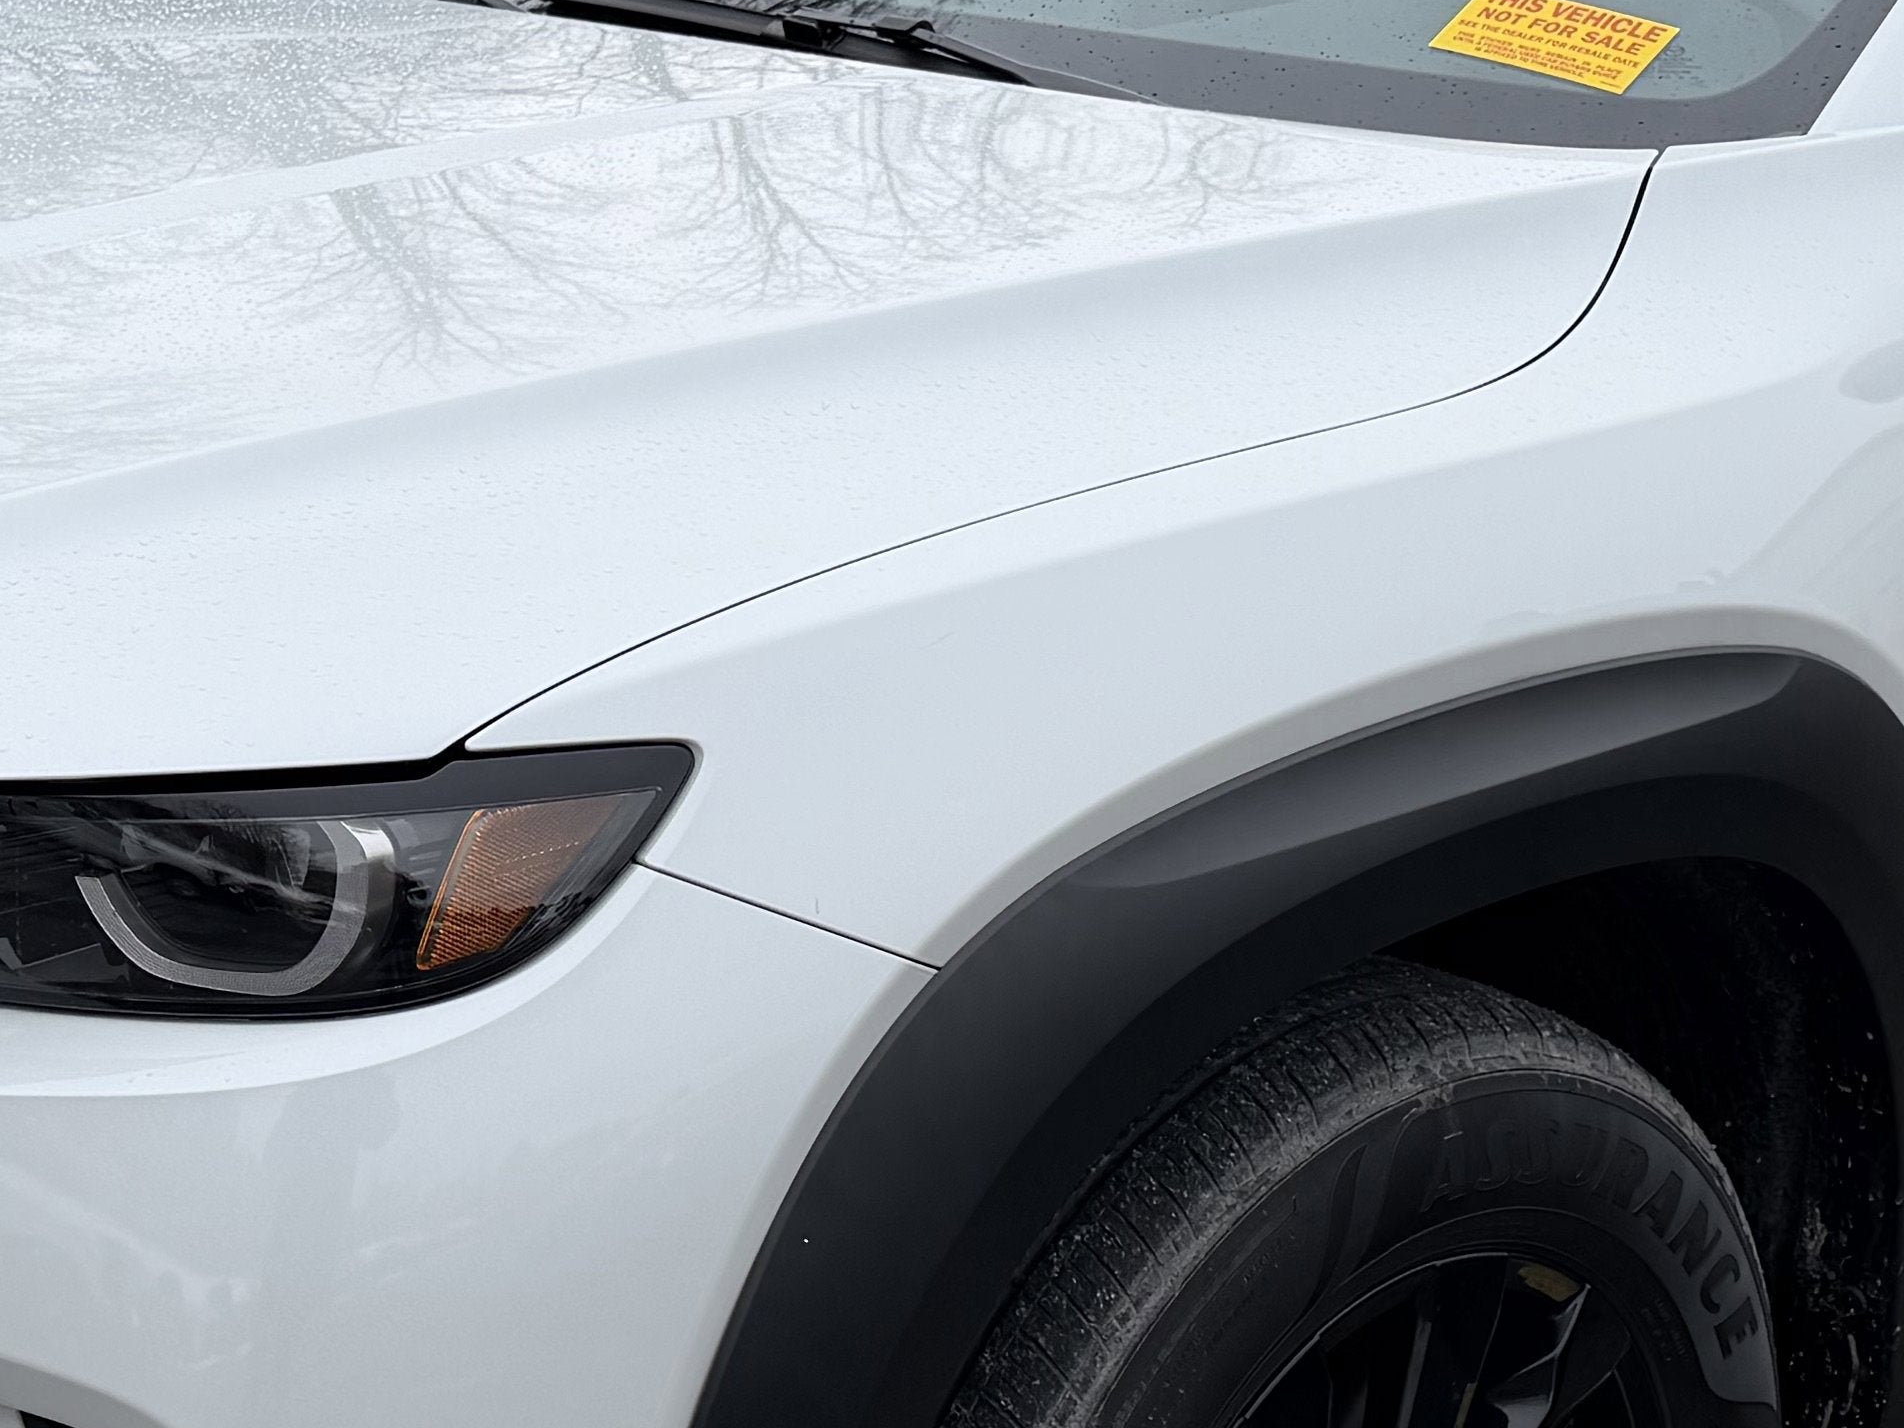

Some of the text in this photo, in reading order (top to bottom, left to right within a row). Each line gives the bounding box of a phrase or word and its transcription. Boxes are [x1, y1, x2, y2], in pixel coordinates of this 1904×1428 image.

[1458, 19, 1641, 69] SEE THE DEALER FOR RESALE DATE
[1476, 6, 1646, 57] NOT FOR SALE
[1552, 1, 1668, 43] VEHICLE
[1420, 1116, 1759, 1361] ASSURANCE
